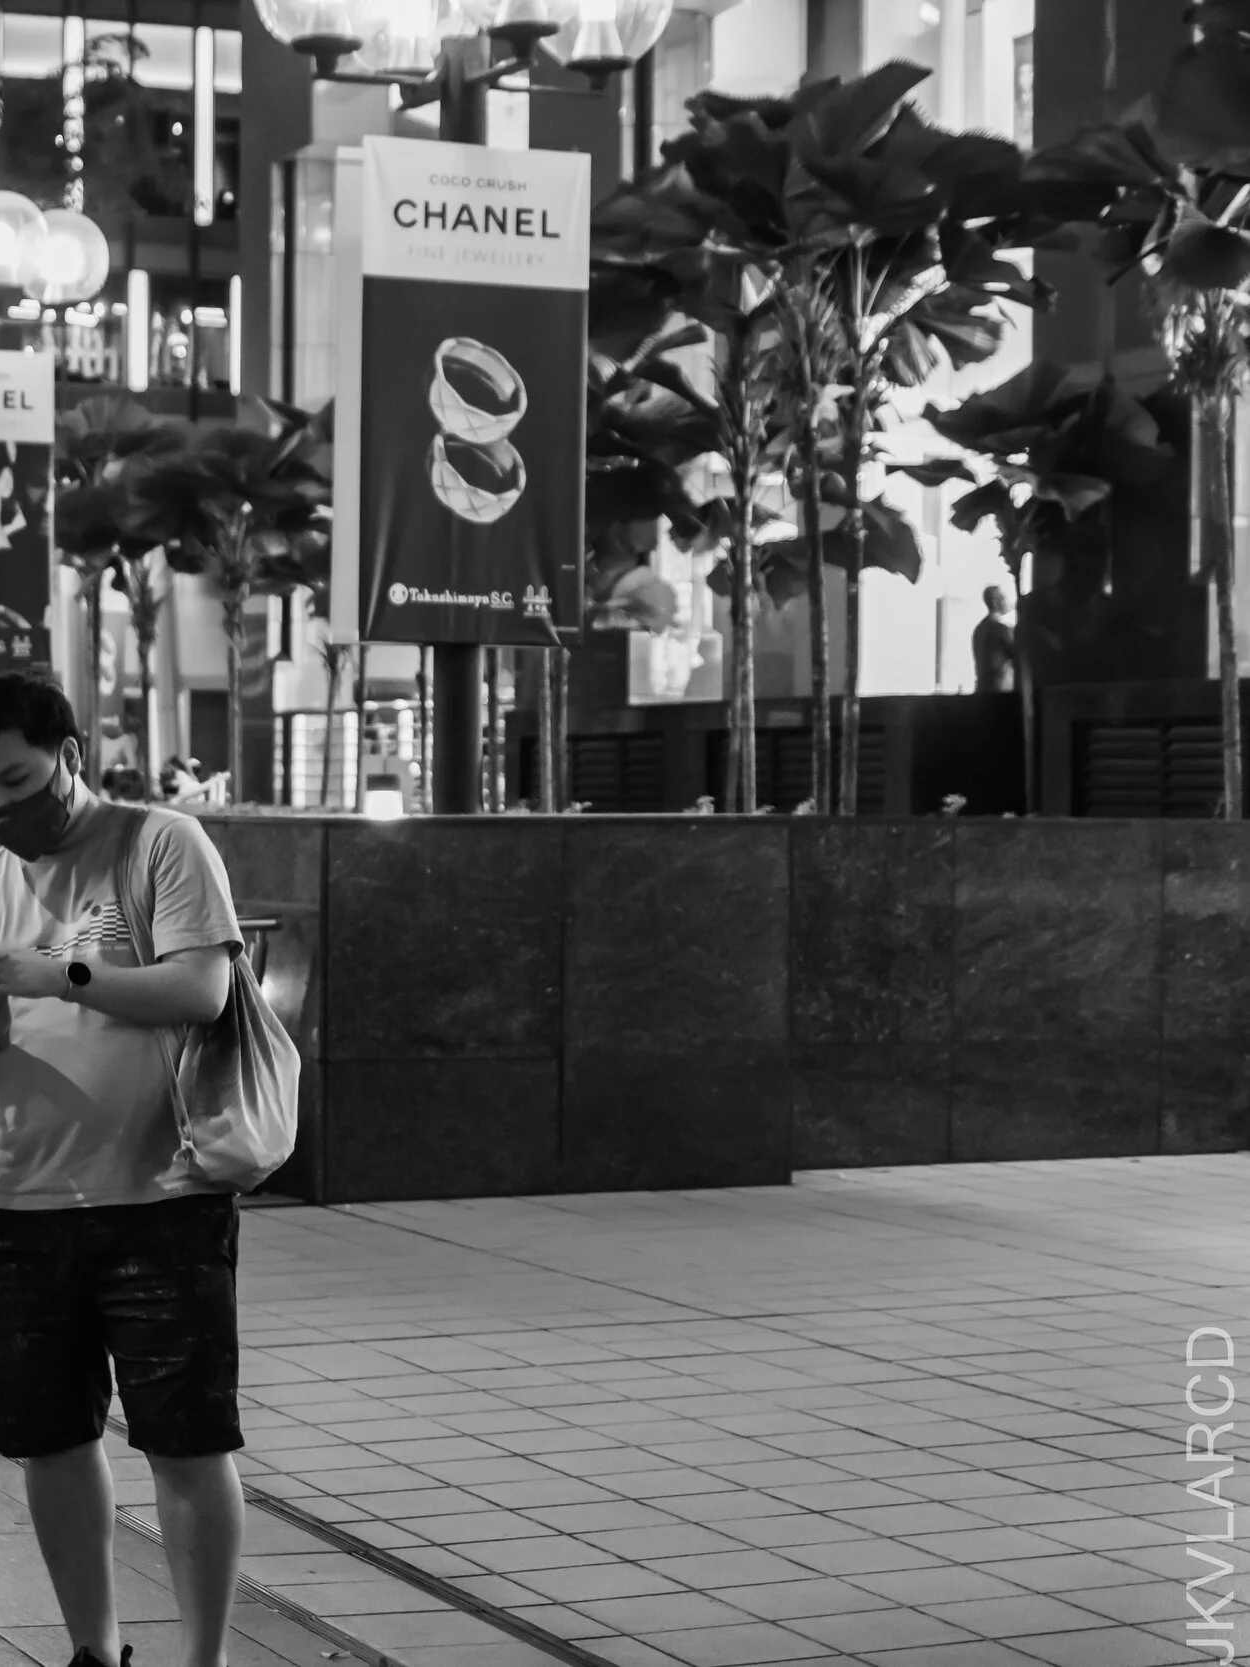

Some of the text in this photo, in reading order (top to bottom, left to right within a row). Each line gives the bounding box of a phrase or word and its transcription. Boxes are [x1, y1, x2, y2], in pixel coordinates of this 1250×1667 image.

[429, 174, 527, 192] COCO CRUSH
[393, 199, 560, 238] CHANEL
[408, 587, 489, 607] Takashimaya
